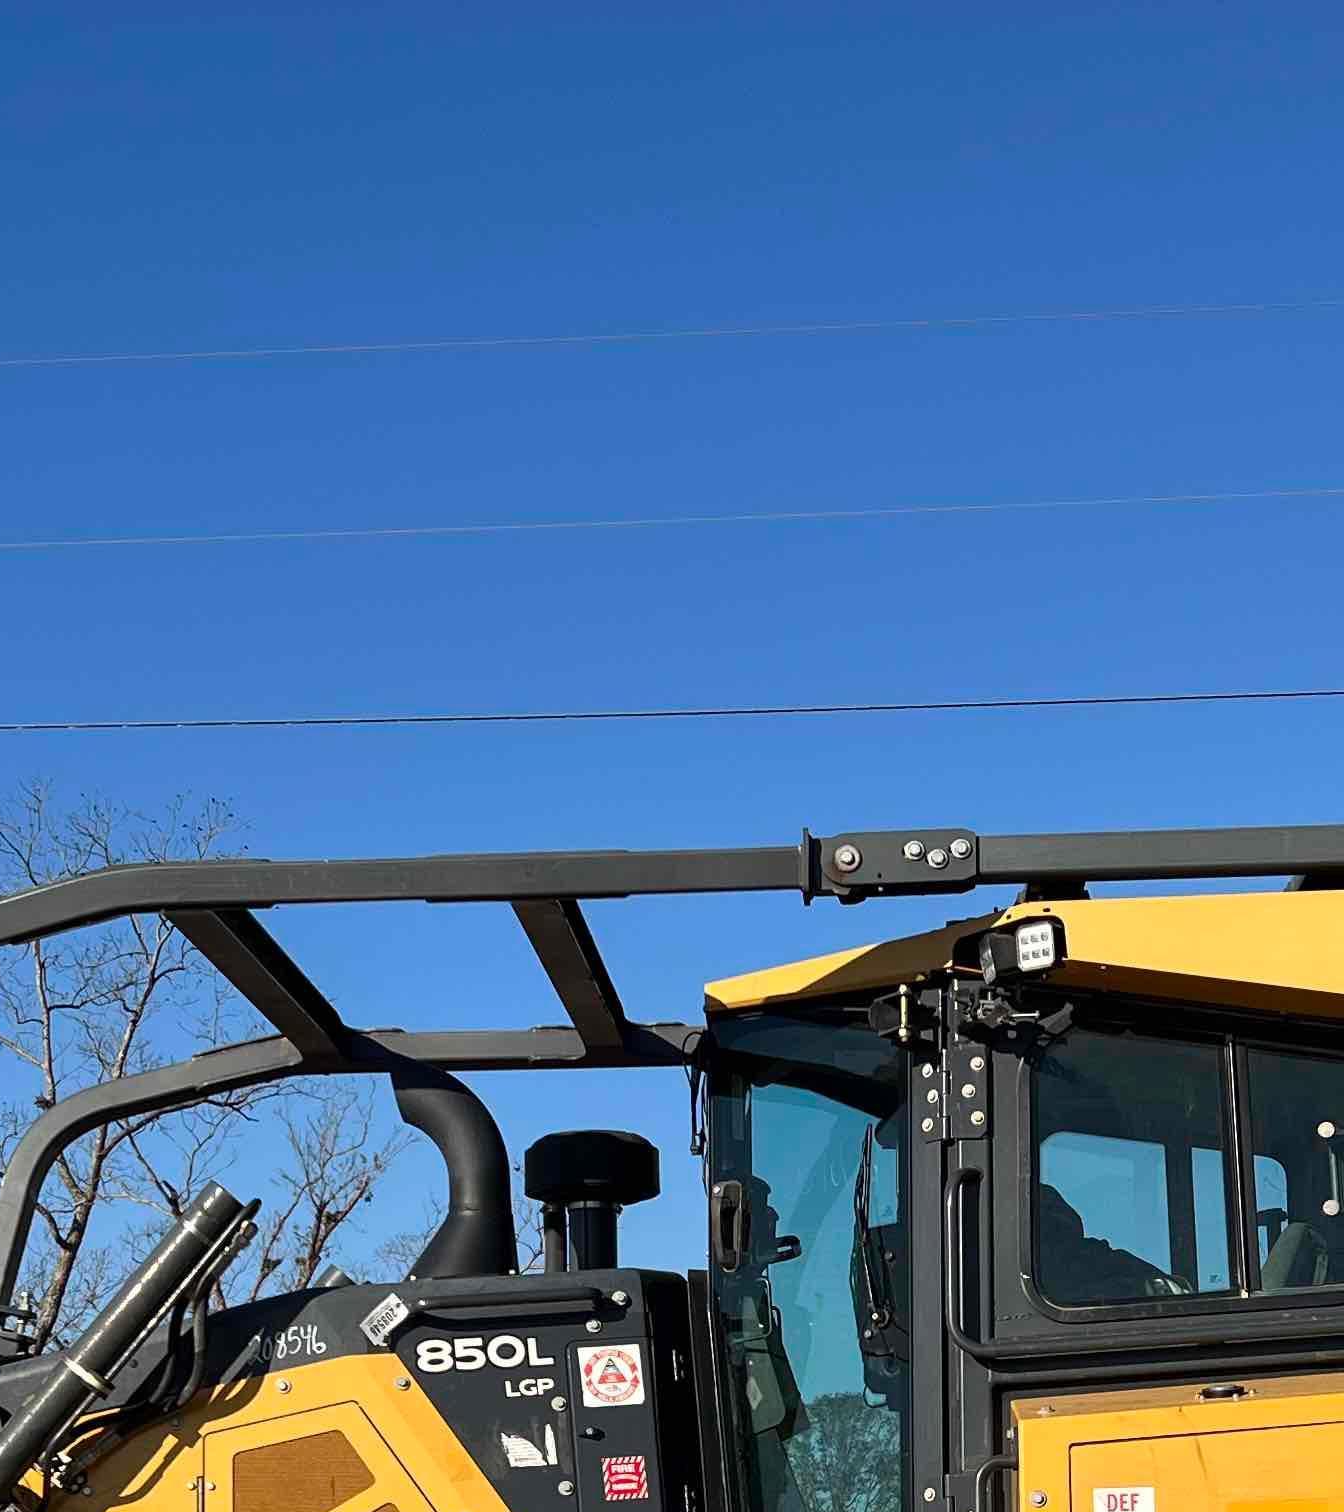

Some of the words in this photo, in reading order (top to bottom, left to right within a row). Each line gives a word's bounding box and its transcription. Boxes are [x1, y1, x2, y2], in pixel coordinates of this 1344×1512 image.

[416, 1334, 555, 1373] 850L
[504, 1377, 555, 1398] LGP
[611, 1463, 635, 1473] FIRE
[1107, 1493, 1140, 1512] DEF
